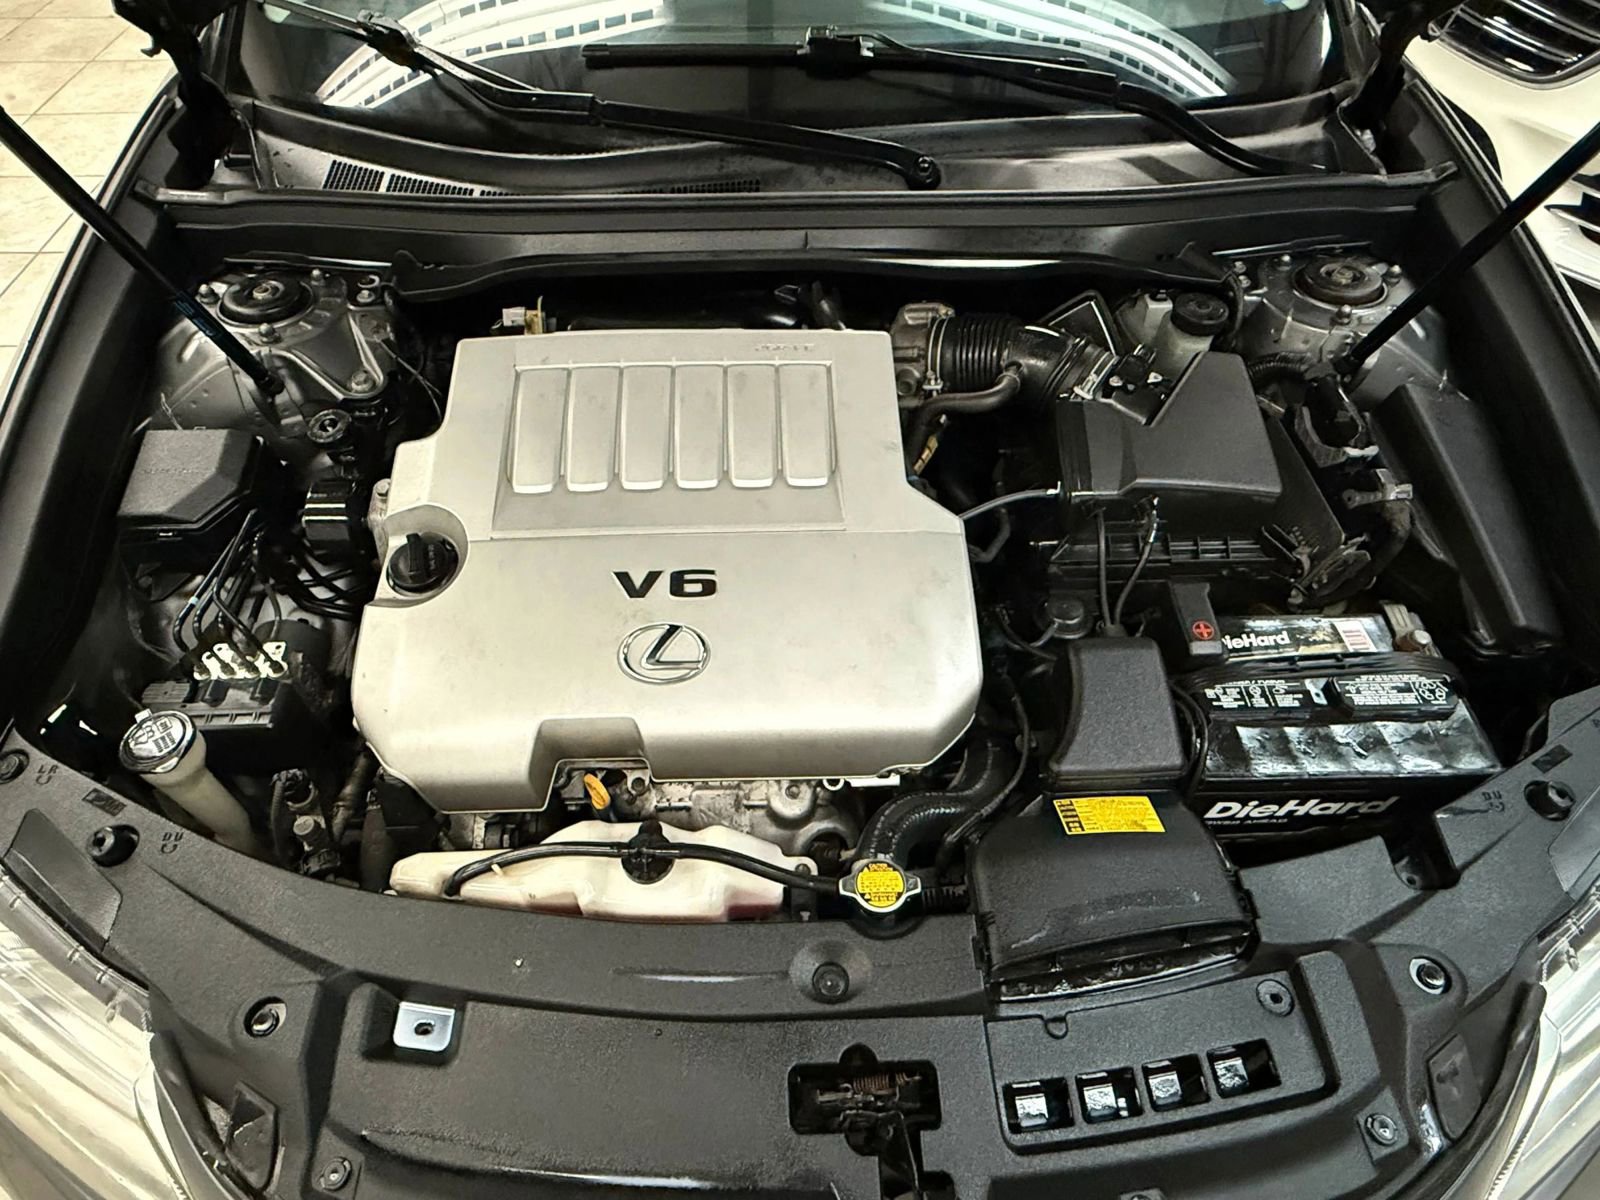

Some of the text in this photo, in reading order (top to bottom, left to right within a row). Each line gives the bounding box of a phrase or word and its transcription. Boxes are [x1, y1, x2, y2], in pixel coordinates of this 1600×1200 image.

[612, 569, 717, 598] V6
[1222, 631, 1290, 649] ieHard
[1203, 796, 1399, 819] DieHard
